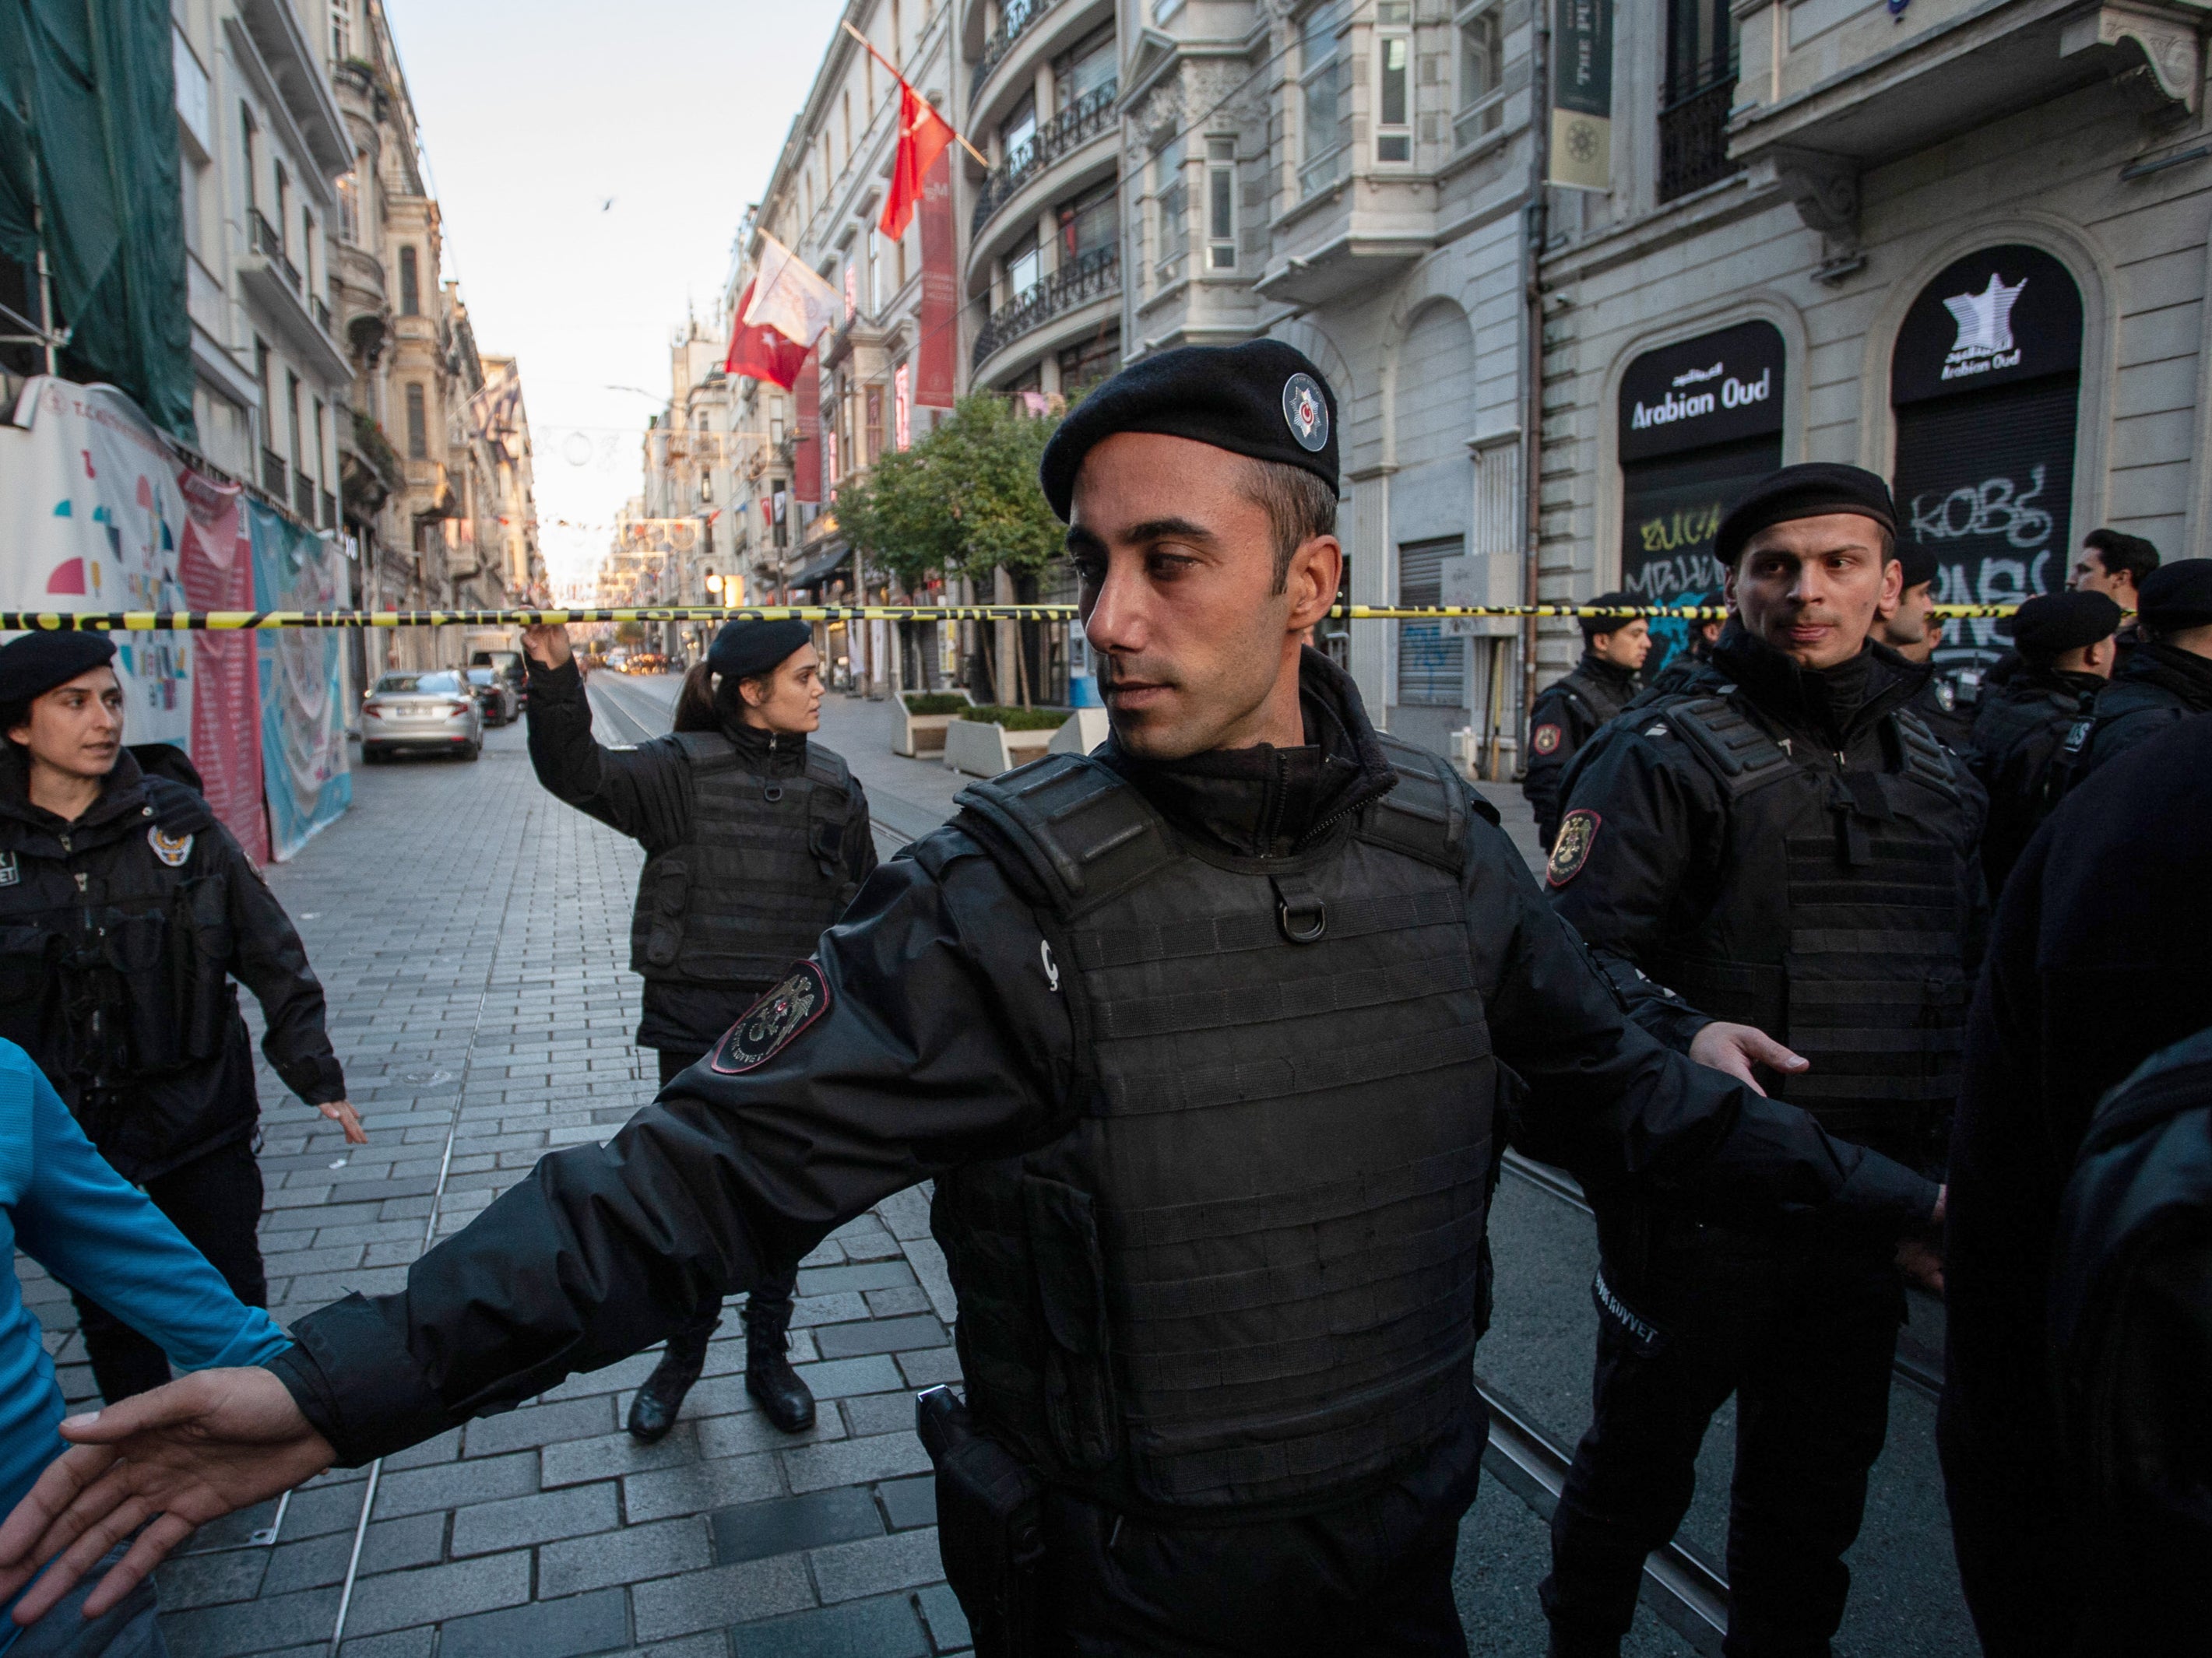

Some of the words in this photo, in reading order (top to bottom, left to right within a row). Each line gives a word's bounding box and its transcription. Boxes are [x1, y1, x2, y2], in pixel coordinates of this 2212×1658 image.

[1941, 360, 1991, 381] Arabian
[1992, 348, 2021, 369] Oud
[1632, 392, 1714, 430] Arabian
[1721, 367, 1771, 409] Oud
